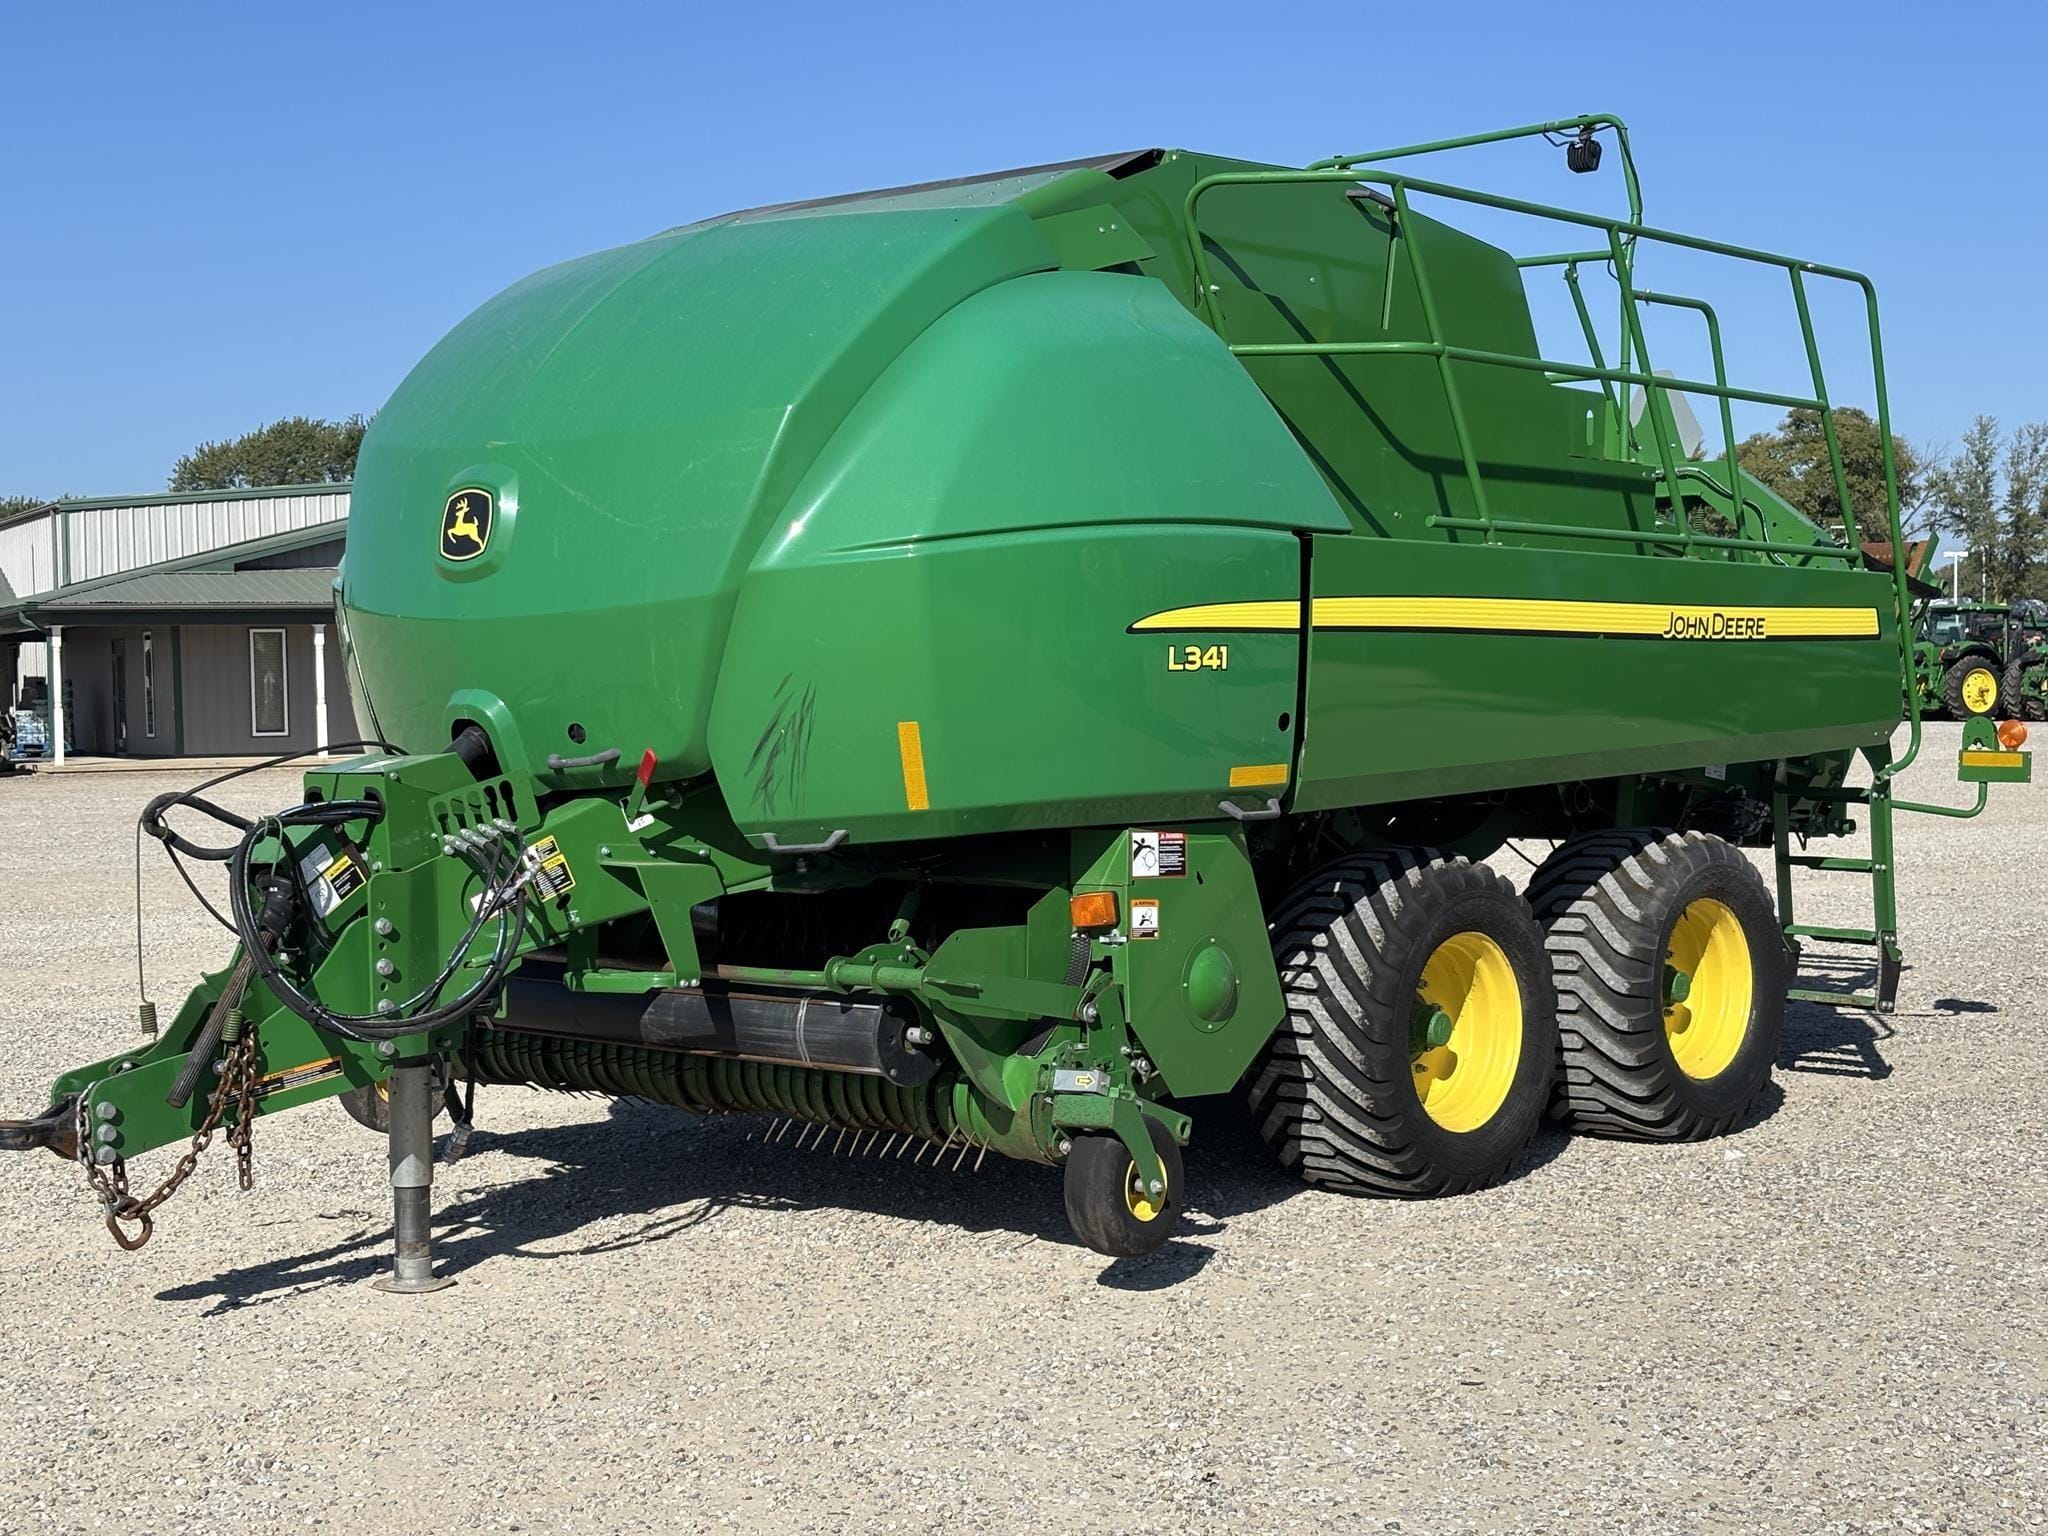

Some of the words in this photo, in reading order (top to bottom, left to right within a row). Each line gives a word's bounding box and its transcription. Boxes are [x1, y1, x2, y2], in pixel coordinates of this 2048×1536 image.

[1663, 611, 1710, 636] JOHN
[1711, 612, 1766, 637] DEERE
[1168, 645, 1228, 671] L341
